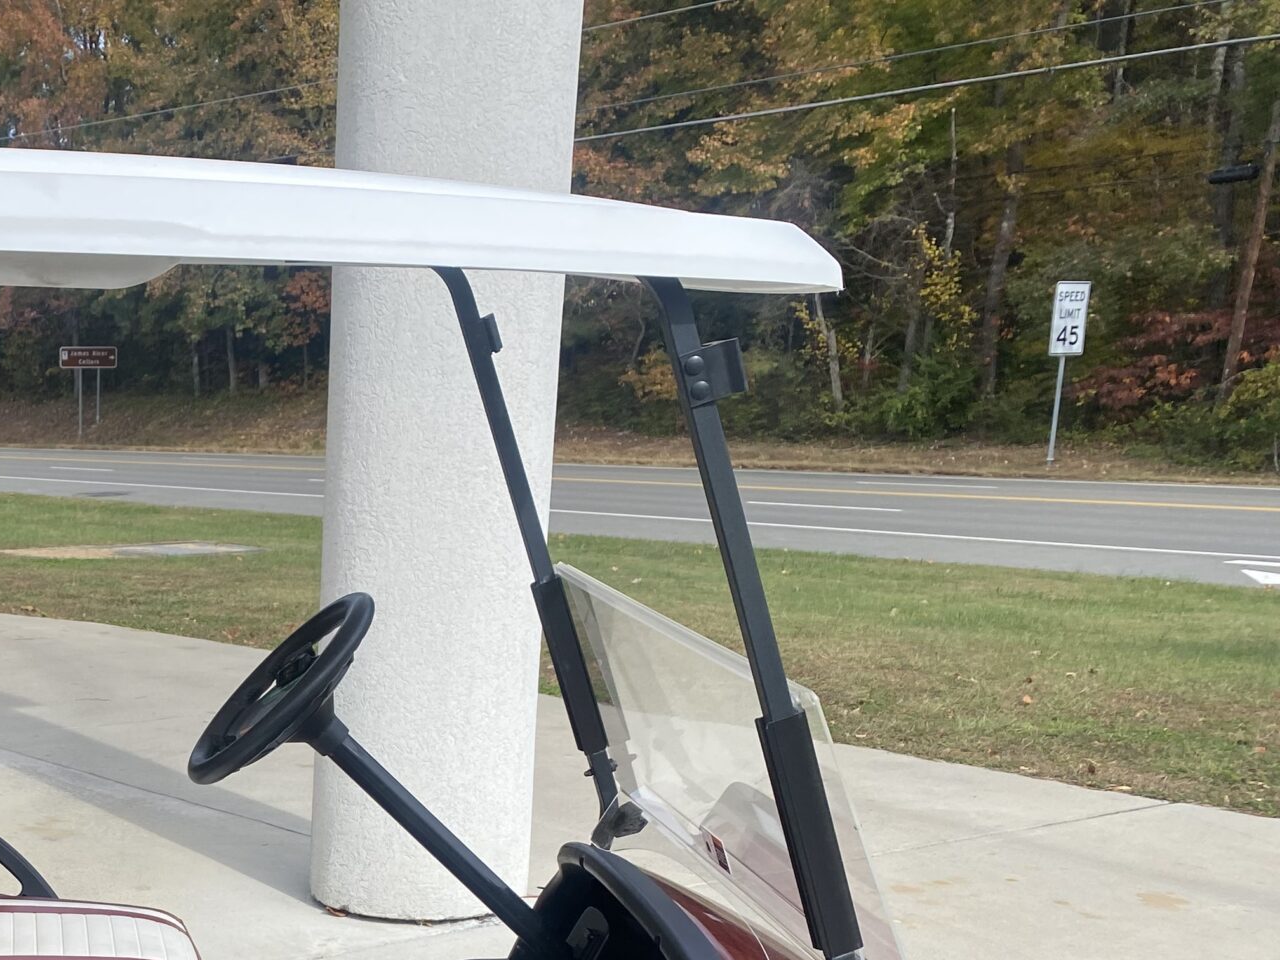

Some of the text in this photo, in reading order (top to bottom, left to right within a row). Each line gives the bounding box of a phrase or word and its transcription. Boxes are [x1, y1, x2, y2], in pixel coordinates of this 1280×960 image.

[1058, 290, 1086, 302] SPEED
[1059, 308, 1081, 319] LIMIT
[1056, 325, 1079, 346] 45
